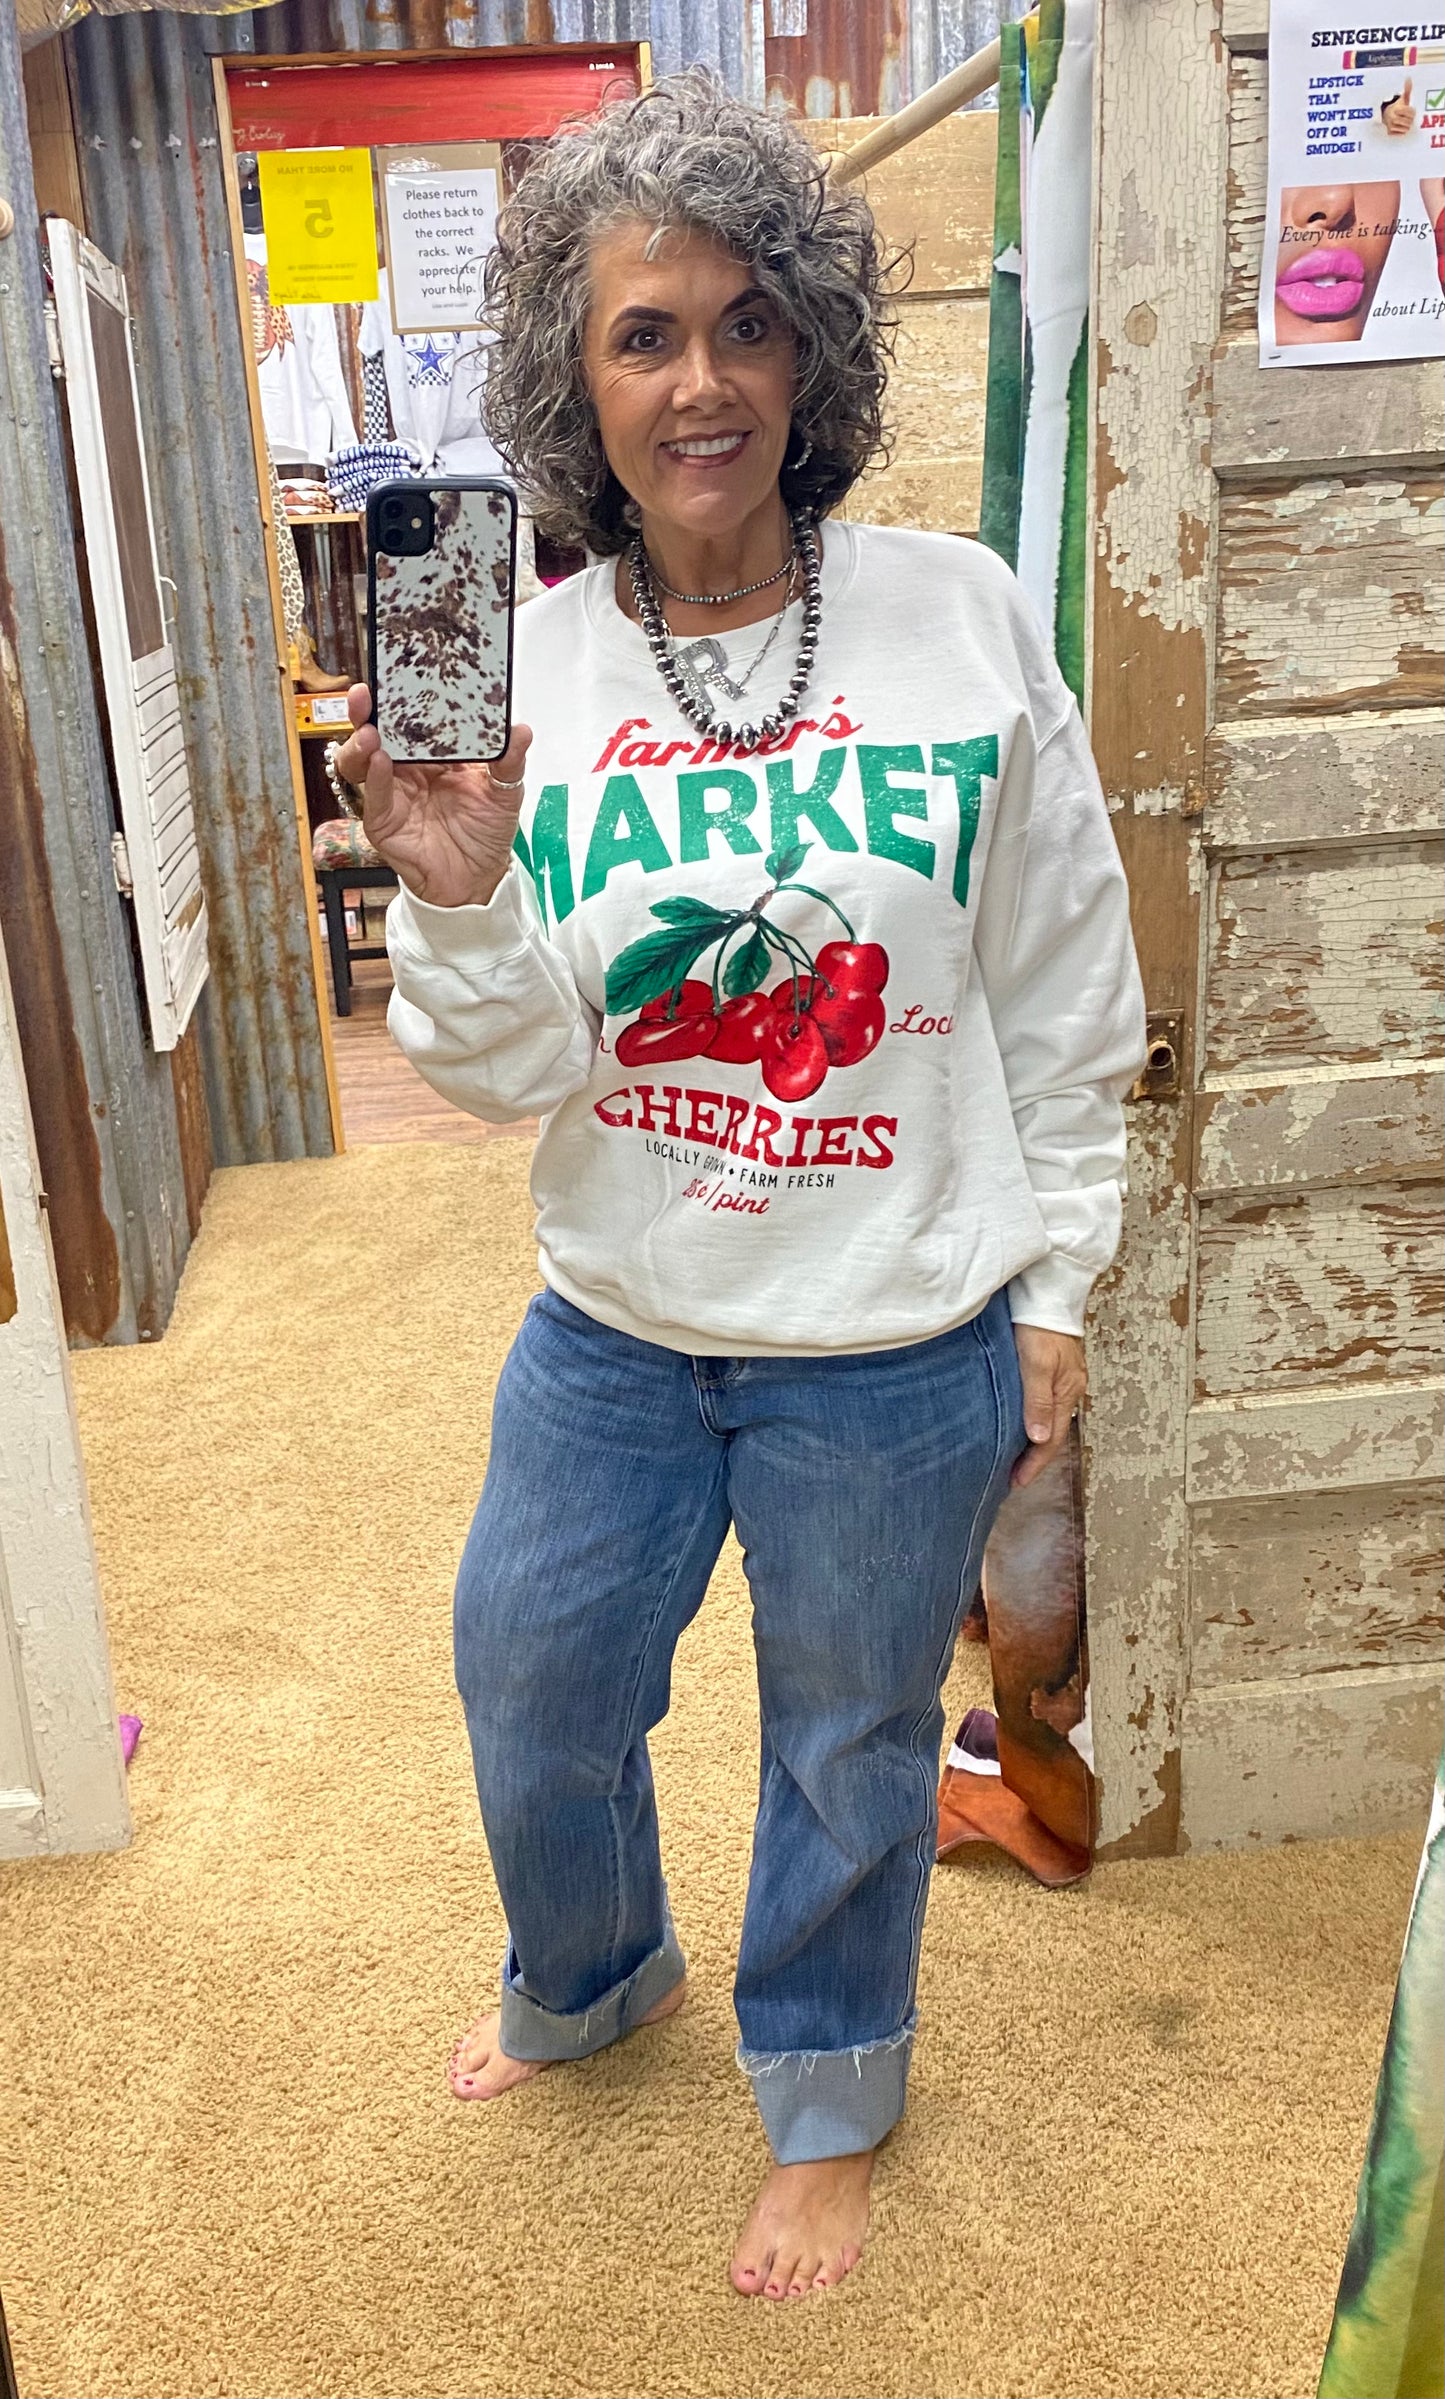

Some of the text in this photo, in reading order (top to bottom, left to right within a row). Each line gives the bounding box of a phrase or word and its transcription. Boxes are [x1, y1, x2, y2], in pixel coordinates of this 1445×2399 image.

[1311, 26, 1418, 48] SENEGENCE
[1309, 75, 1364, 89] LIPSTICK
[1308, 93, 1340, 106] THAT
[1307, 107, 1373, 122] WON'T KISS
[1307, 126, 1347, 139] OFF OR
[1306, 142, 1355, 155] SMUDGE
[406, 188, 478, 200] Please return
[402, 206, 484, 220] clothes back to
[415, 226, 474, 239] the correct
[1280, 225, 1324, 247] Every
[1327, 229, 1352, 240] one
[1358, 222, 1369, 238] is
[418, 245, 474, 257] racks. We
[418, 264, 476, 278] appreciate
[422, 283, 477, 298] your help.
[1372, 300, 1416, 318] about
[513, 733, 999, 937] MARKET
[594, 1085, 898, 1169] CHERRIES
[645, 1139, 700, 1167] LOCALLY
[739, 1168, 778, 1189] FARM
[787, 1173, 835, 1188] FRESH
